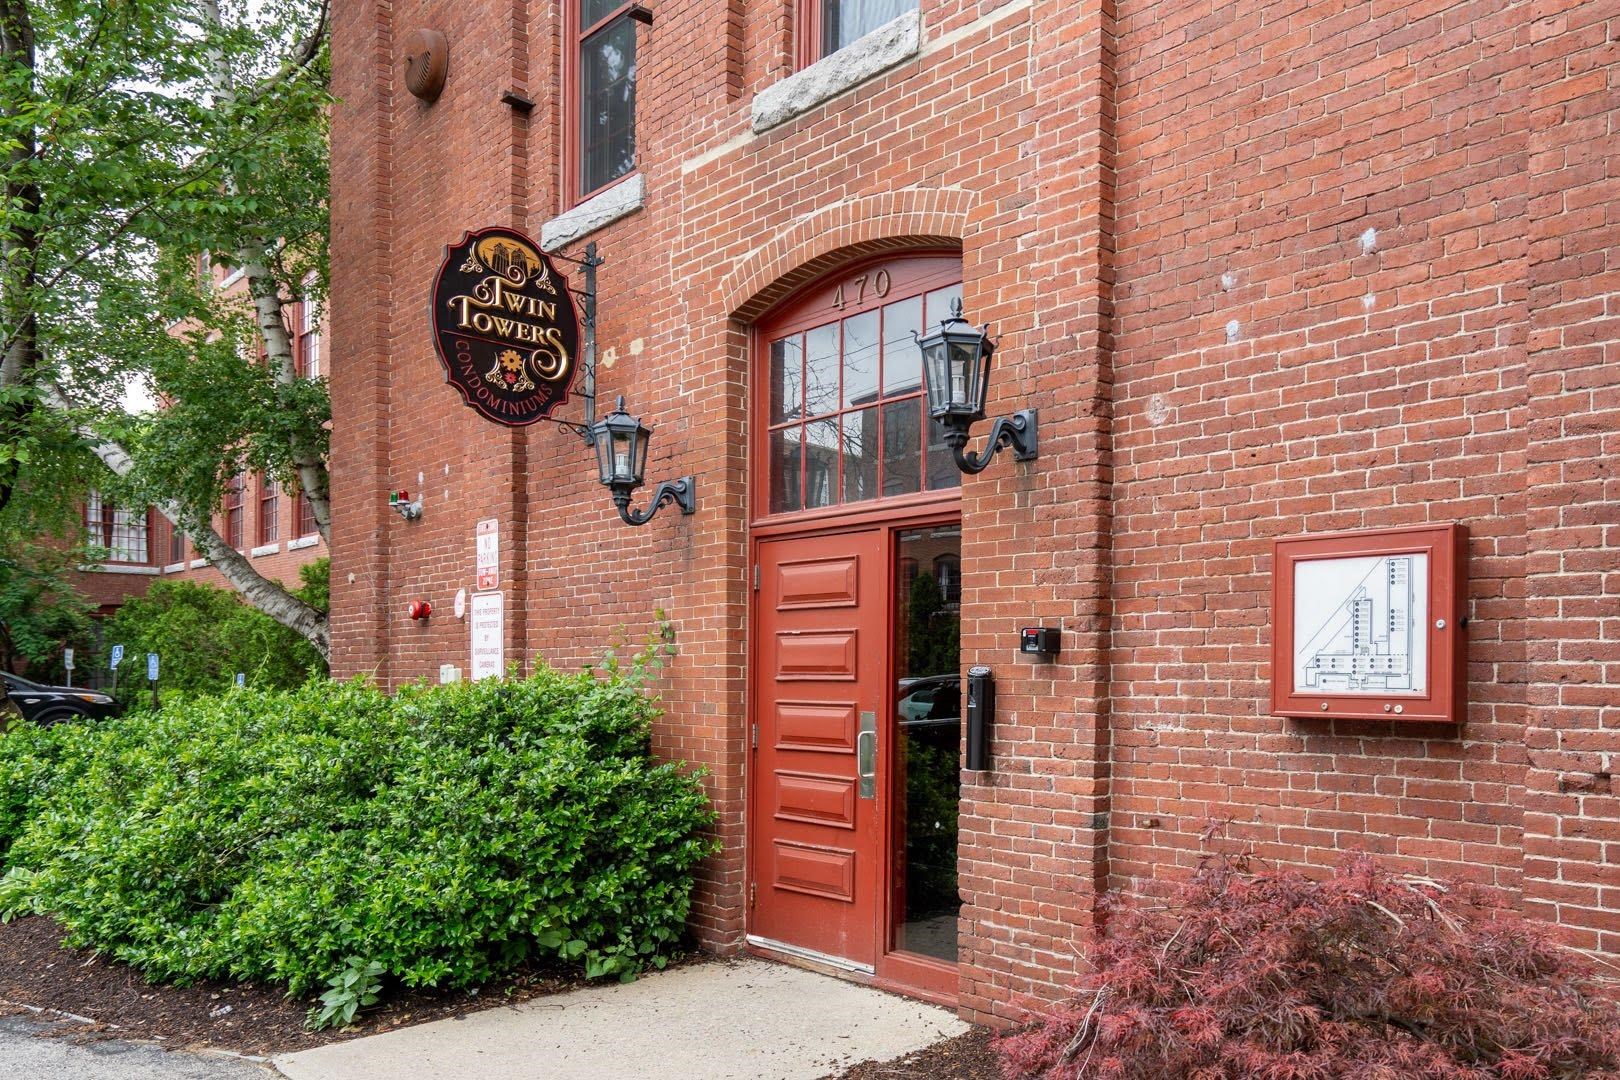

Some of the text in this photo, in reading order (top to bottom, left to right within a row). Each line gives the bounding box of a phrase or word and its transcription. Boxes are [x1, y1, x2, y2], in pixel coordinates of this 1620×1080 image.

[482, 265, 557, 322] TWIN
[832, 268, 891, 311] 470
[448, 283, 568, 381] TOWERS
[455, 340, 553, 416] CONDOMINIUMS
